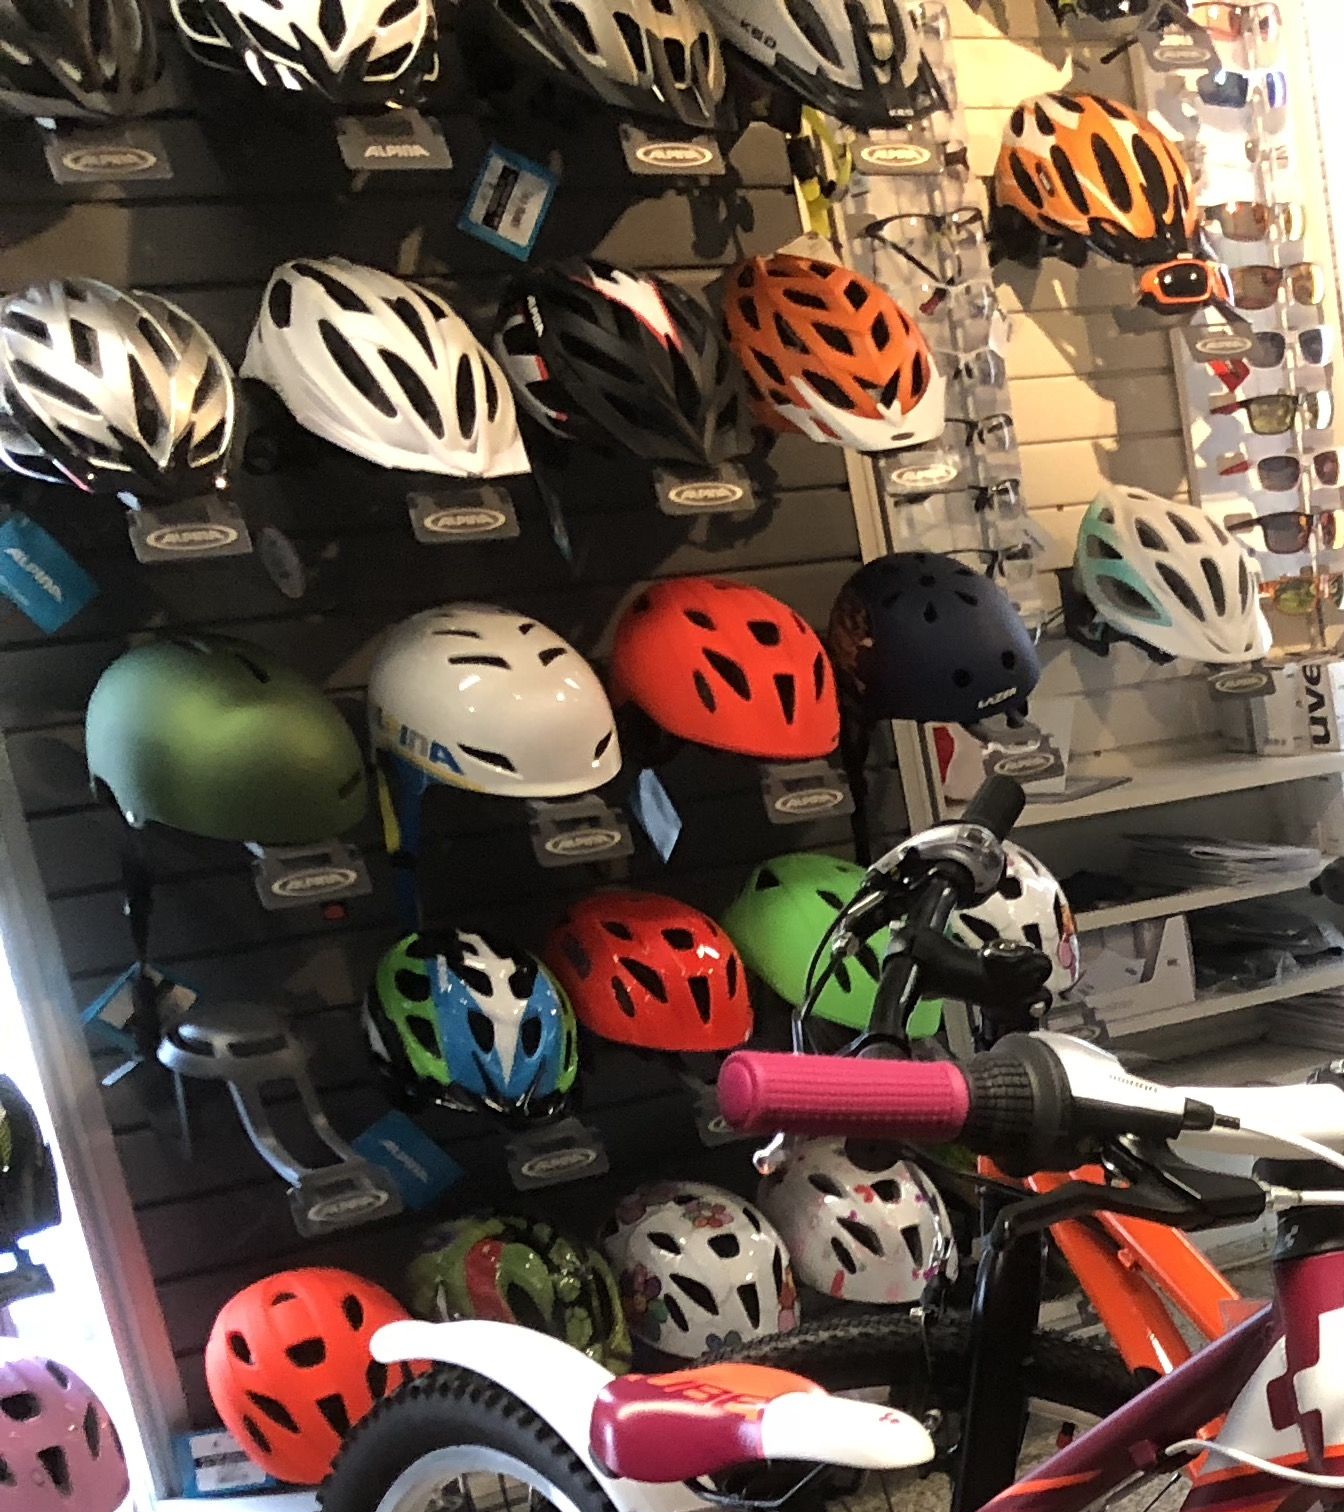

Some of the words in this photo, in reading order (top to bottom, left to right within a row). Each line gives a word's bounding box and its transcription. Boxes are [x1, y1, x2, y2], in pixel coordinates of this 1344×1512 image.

[364, 144, 431, 158] ALPINA
[650, 146, 700, 161] ALPINA
[680, 488, 730, 501] ALPINA
[437, 514, 493, 527] ALPINA
